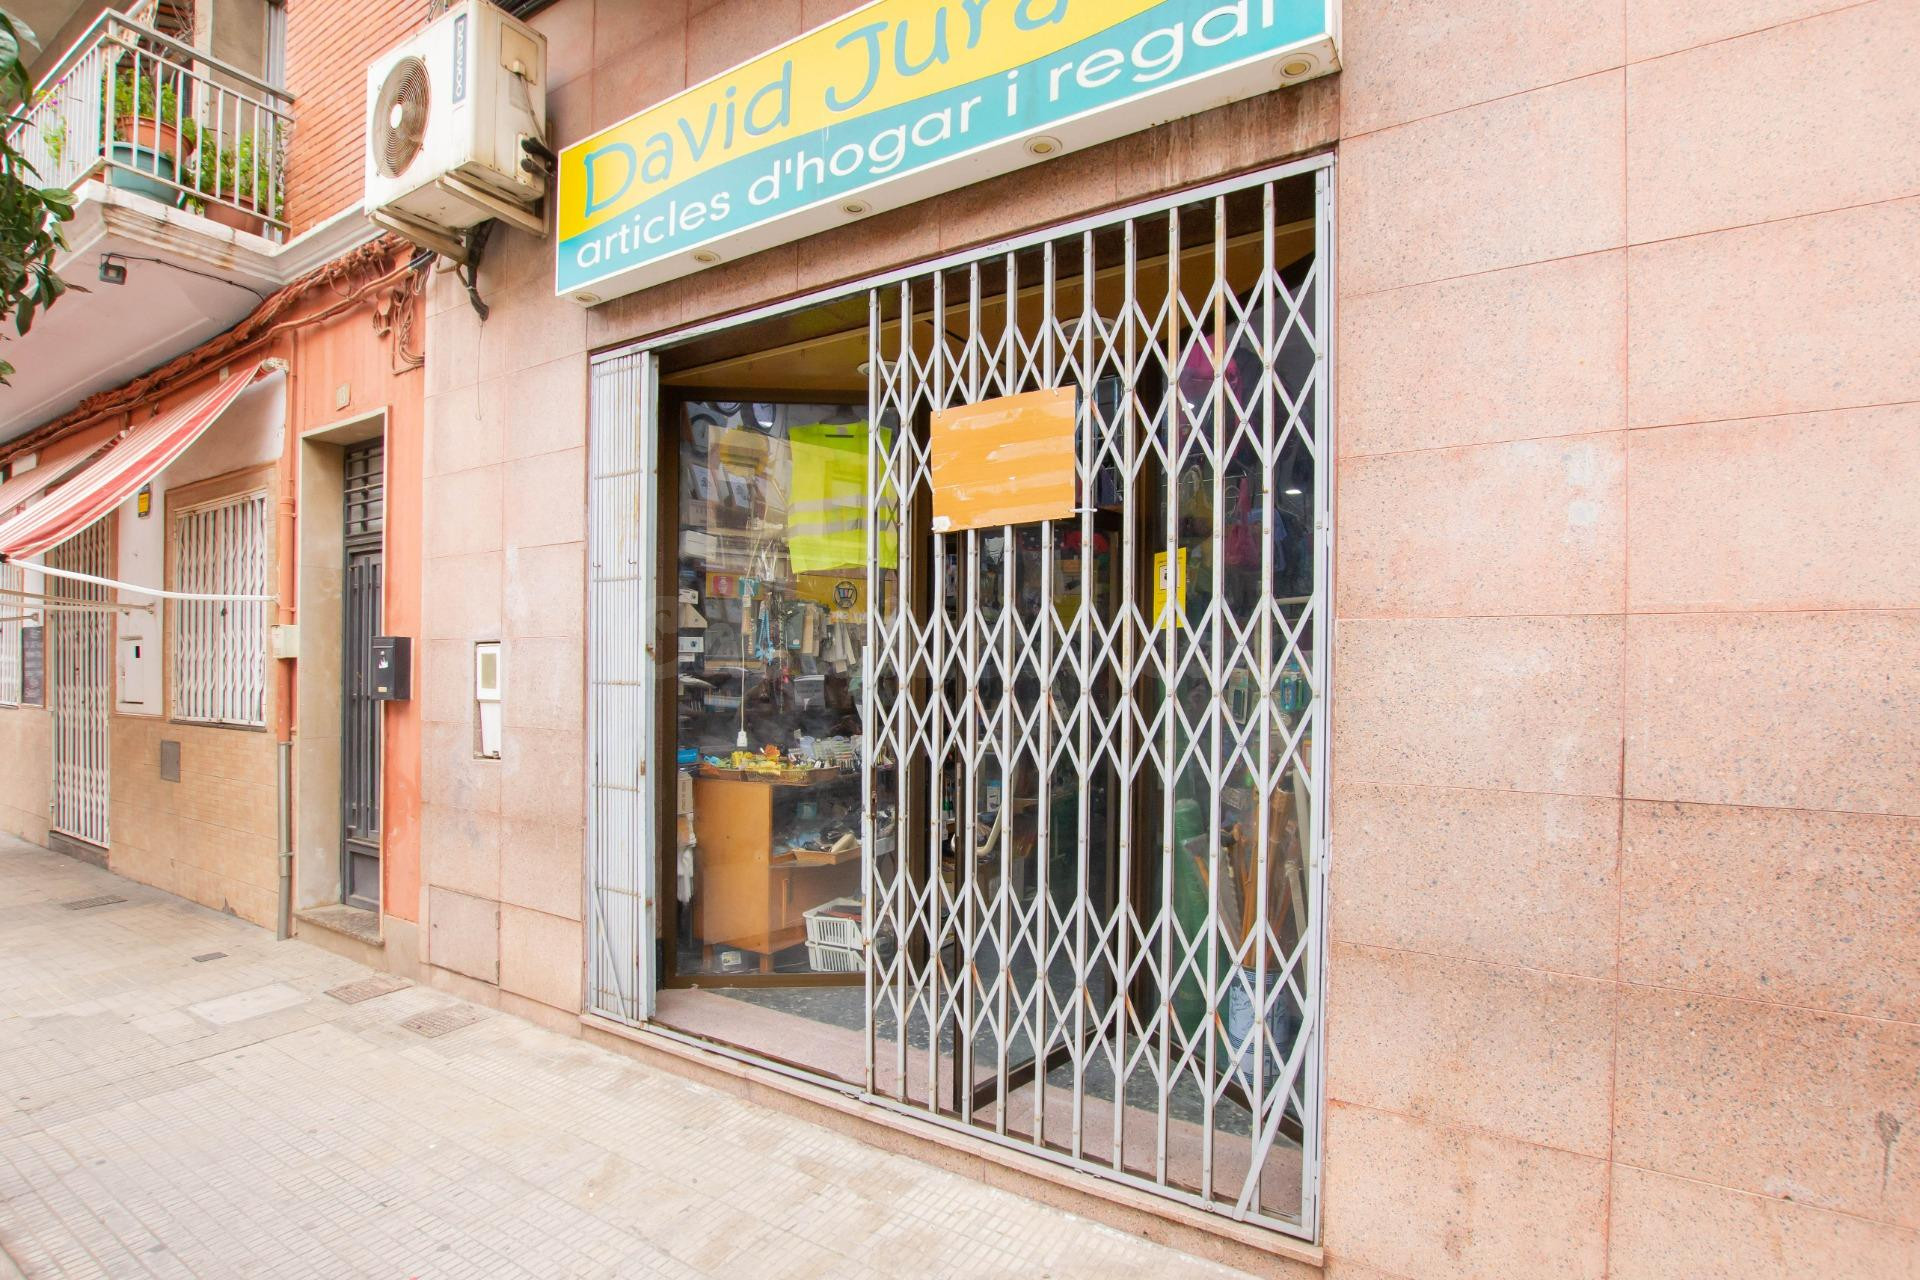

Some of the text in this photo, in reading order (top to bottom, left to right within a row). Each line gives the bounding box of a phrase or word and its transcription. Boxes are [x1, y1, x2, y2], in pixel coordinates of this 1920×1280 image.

[456, 20, 465, 97] DAEWOO
[576, 191, 730, 268] articles
[748, 96, 982, 206] d'hogar
[1007, 69, 1019, 117] i
[584, 60, 793, 218] David
